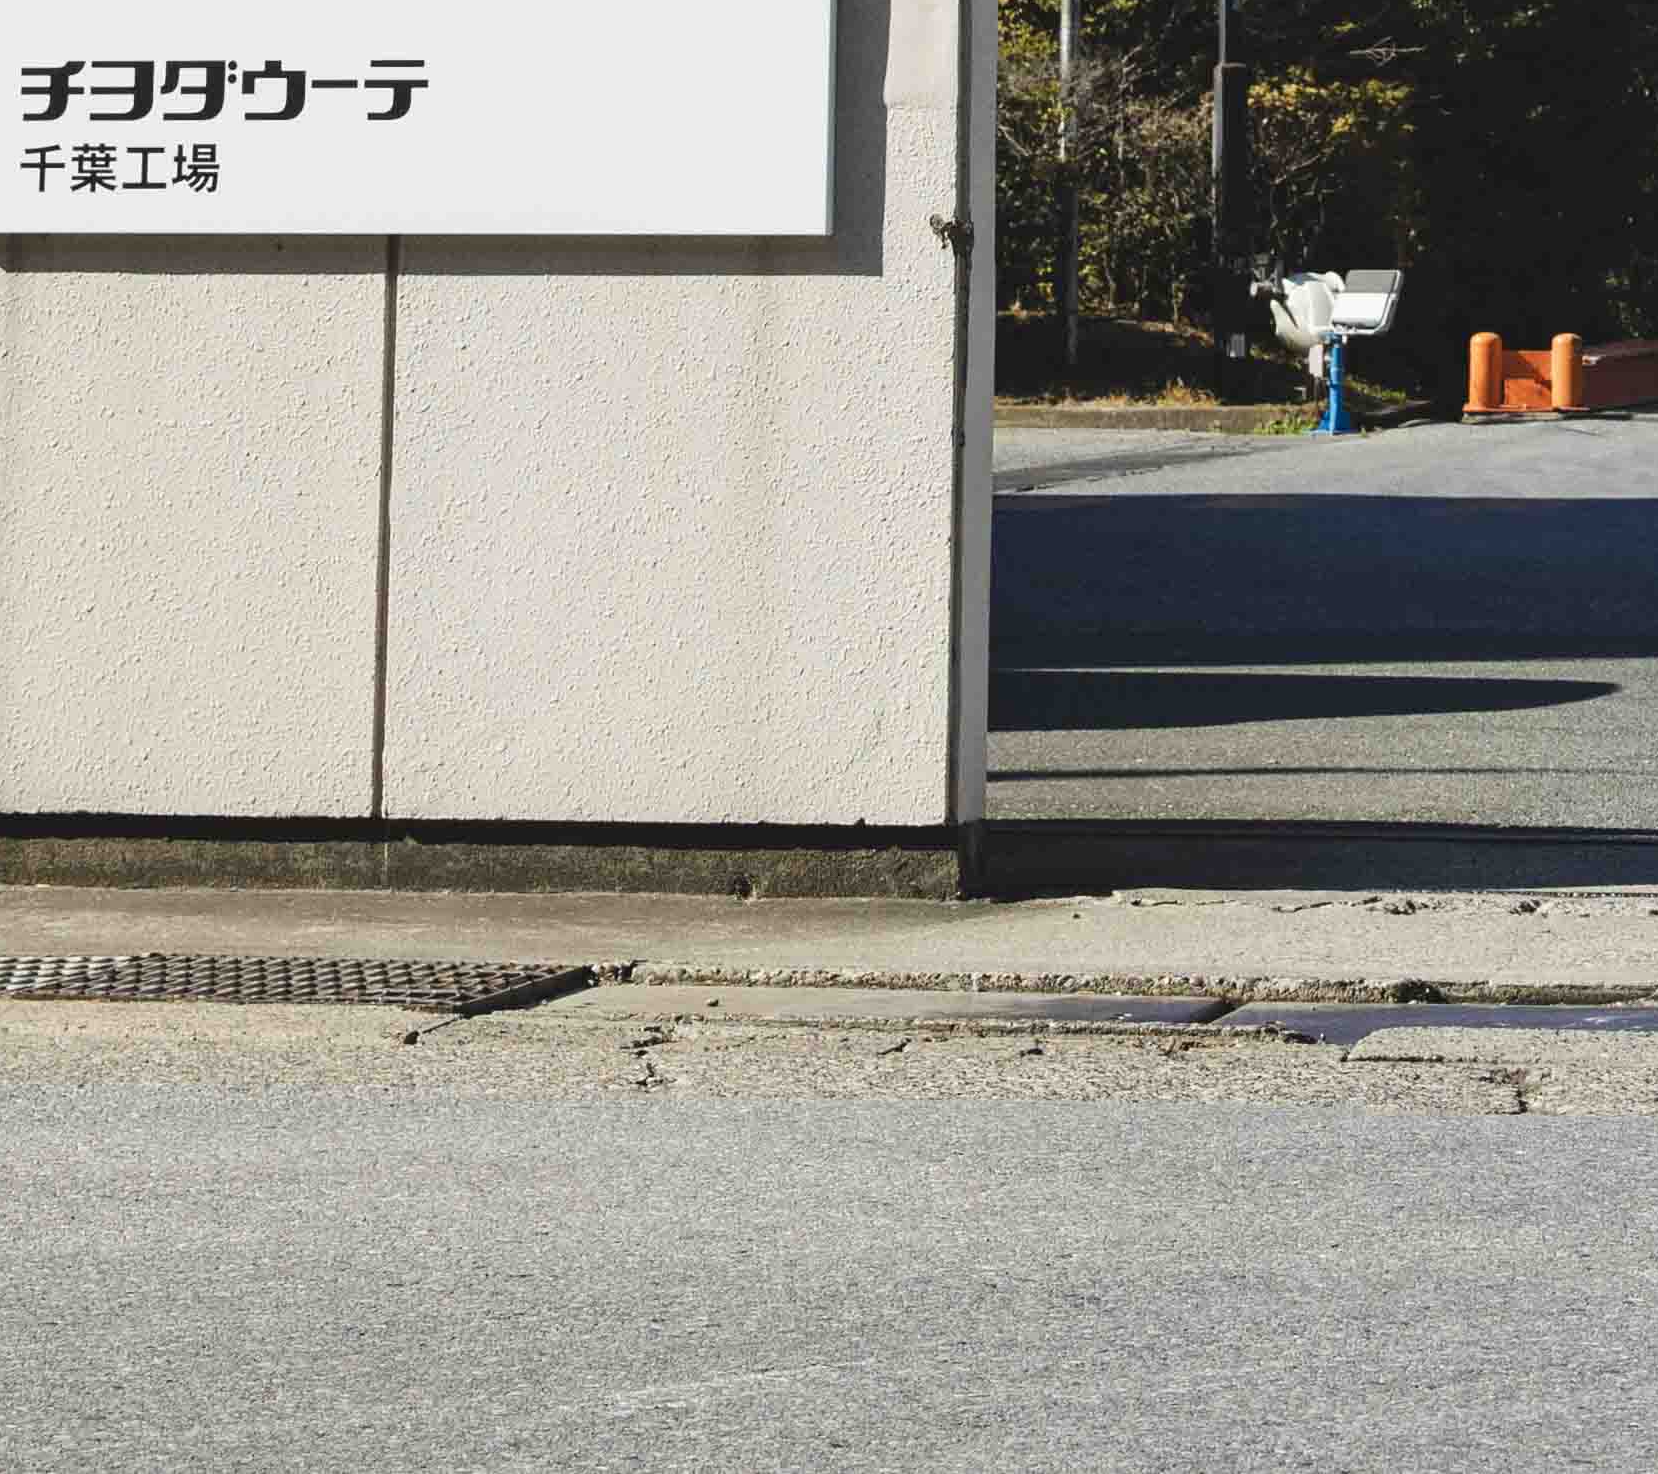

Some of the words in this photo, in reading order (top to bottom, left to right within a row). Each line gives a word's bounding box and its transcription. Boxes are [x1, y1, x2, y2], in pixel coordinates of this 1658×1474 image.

[20, 59, 429, 122] チヨダウーテ
[19, 142, 221, 194] 千葉工場
